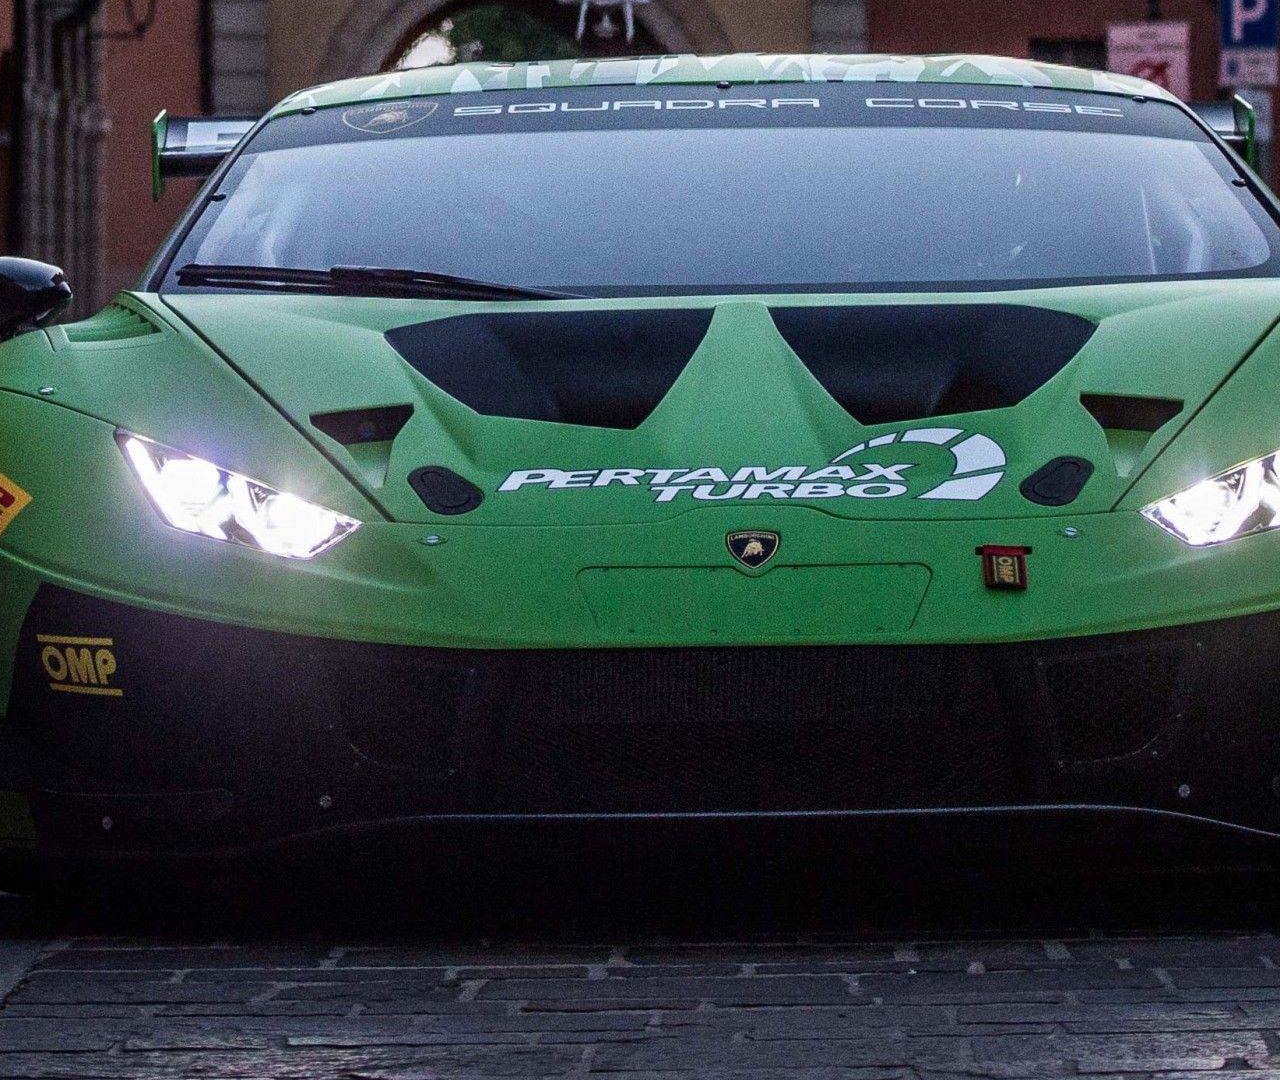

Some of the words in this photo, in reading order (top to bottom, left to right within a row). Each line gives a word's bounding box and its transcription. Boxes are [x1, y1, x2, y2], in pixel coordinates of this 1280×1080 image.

[453, 97, 822, 117] SQUADRA
[864, 97, 1124, 118] CORSE
[496, 463, 916, 492] PERTAMAX
[649, 482, 908, 503] TURBO
[42, 645, 117, 685] OMP
